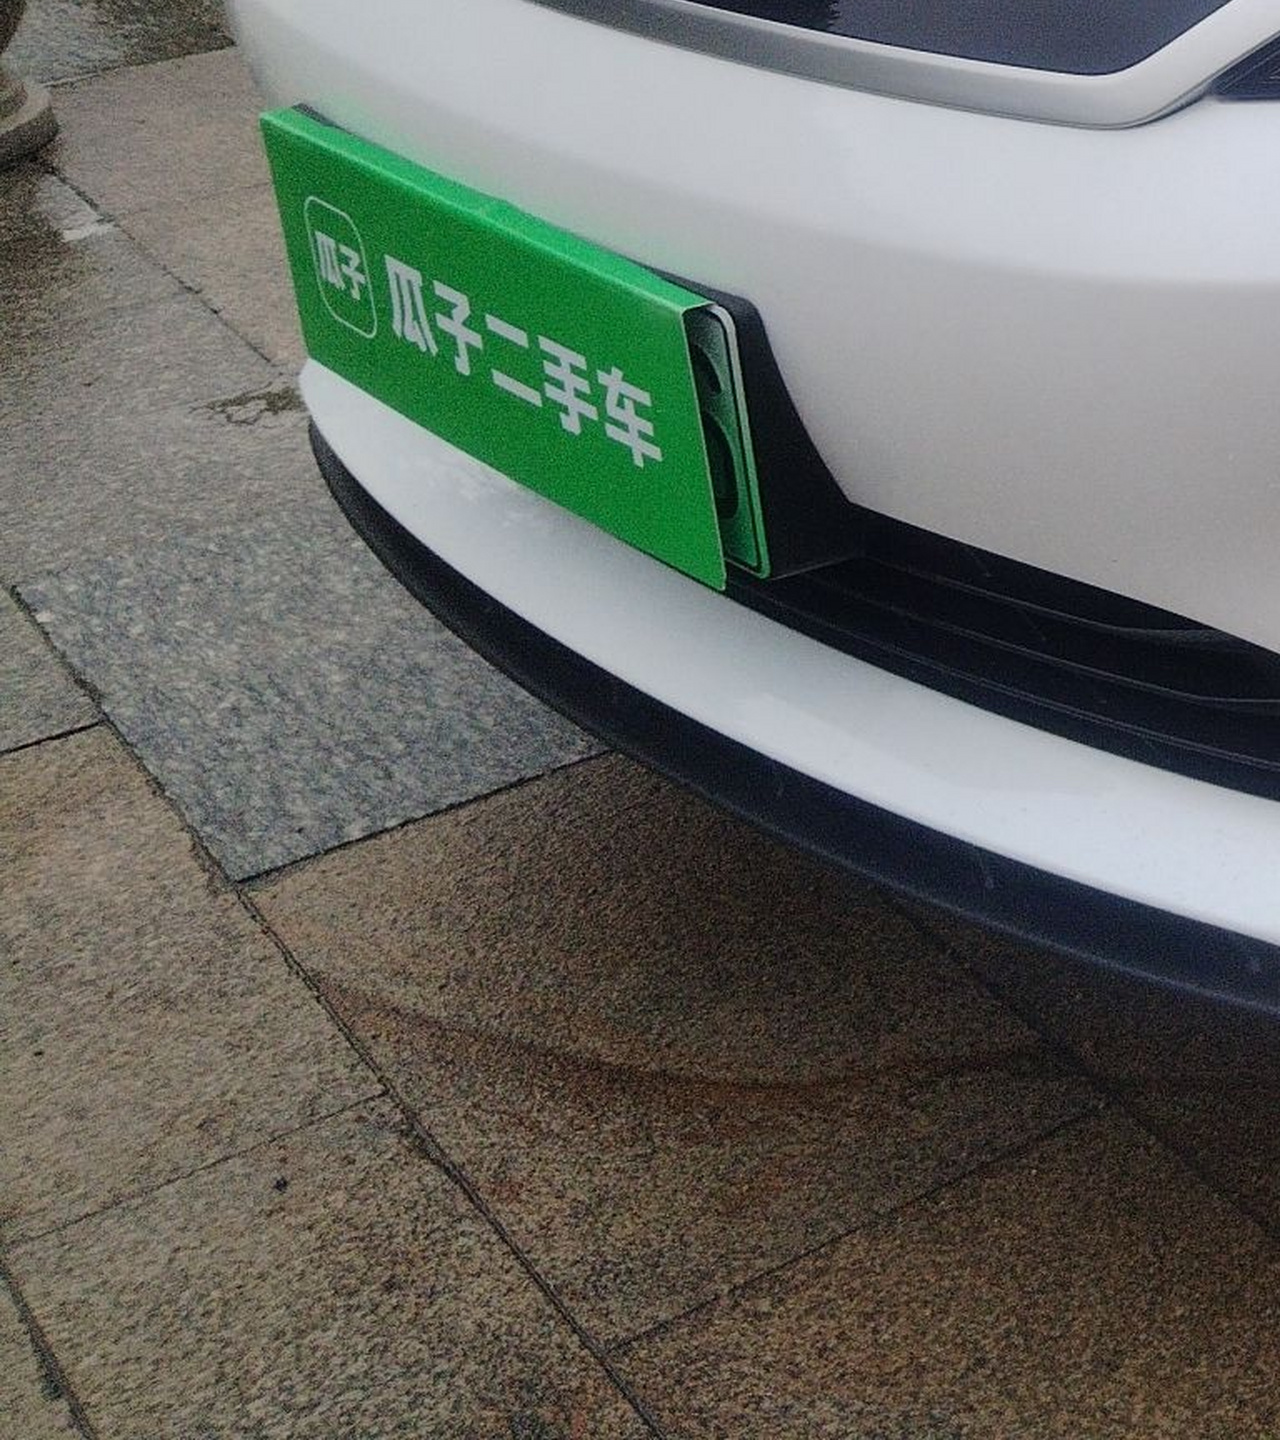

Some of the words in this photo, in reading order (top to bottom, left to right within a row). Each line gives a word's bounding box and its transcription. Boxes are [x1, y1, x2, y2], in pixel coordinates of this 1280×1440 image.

[314, 230, 366, 300] 瓜子
[384, 254, 663, 469] 瓜子二手车
